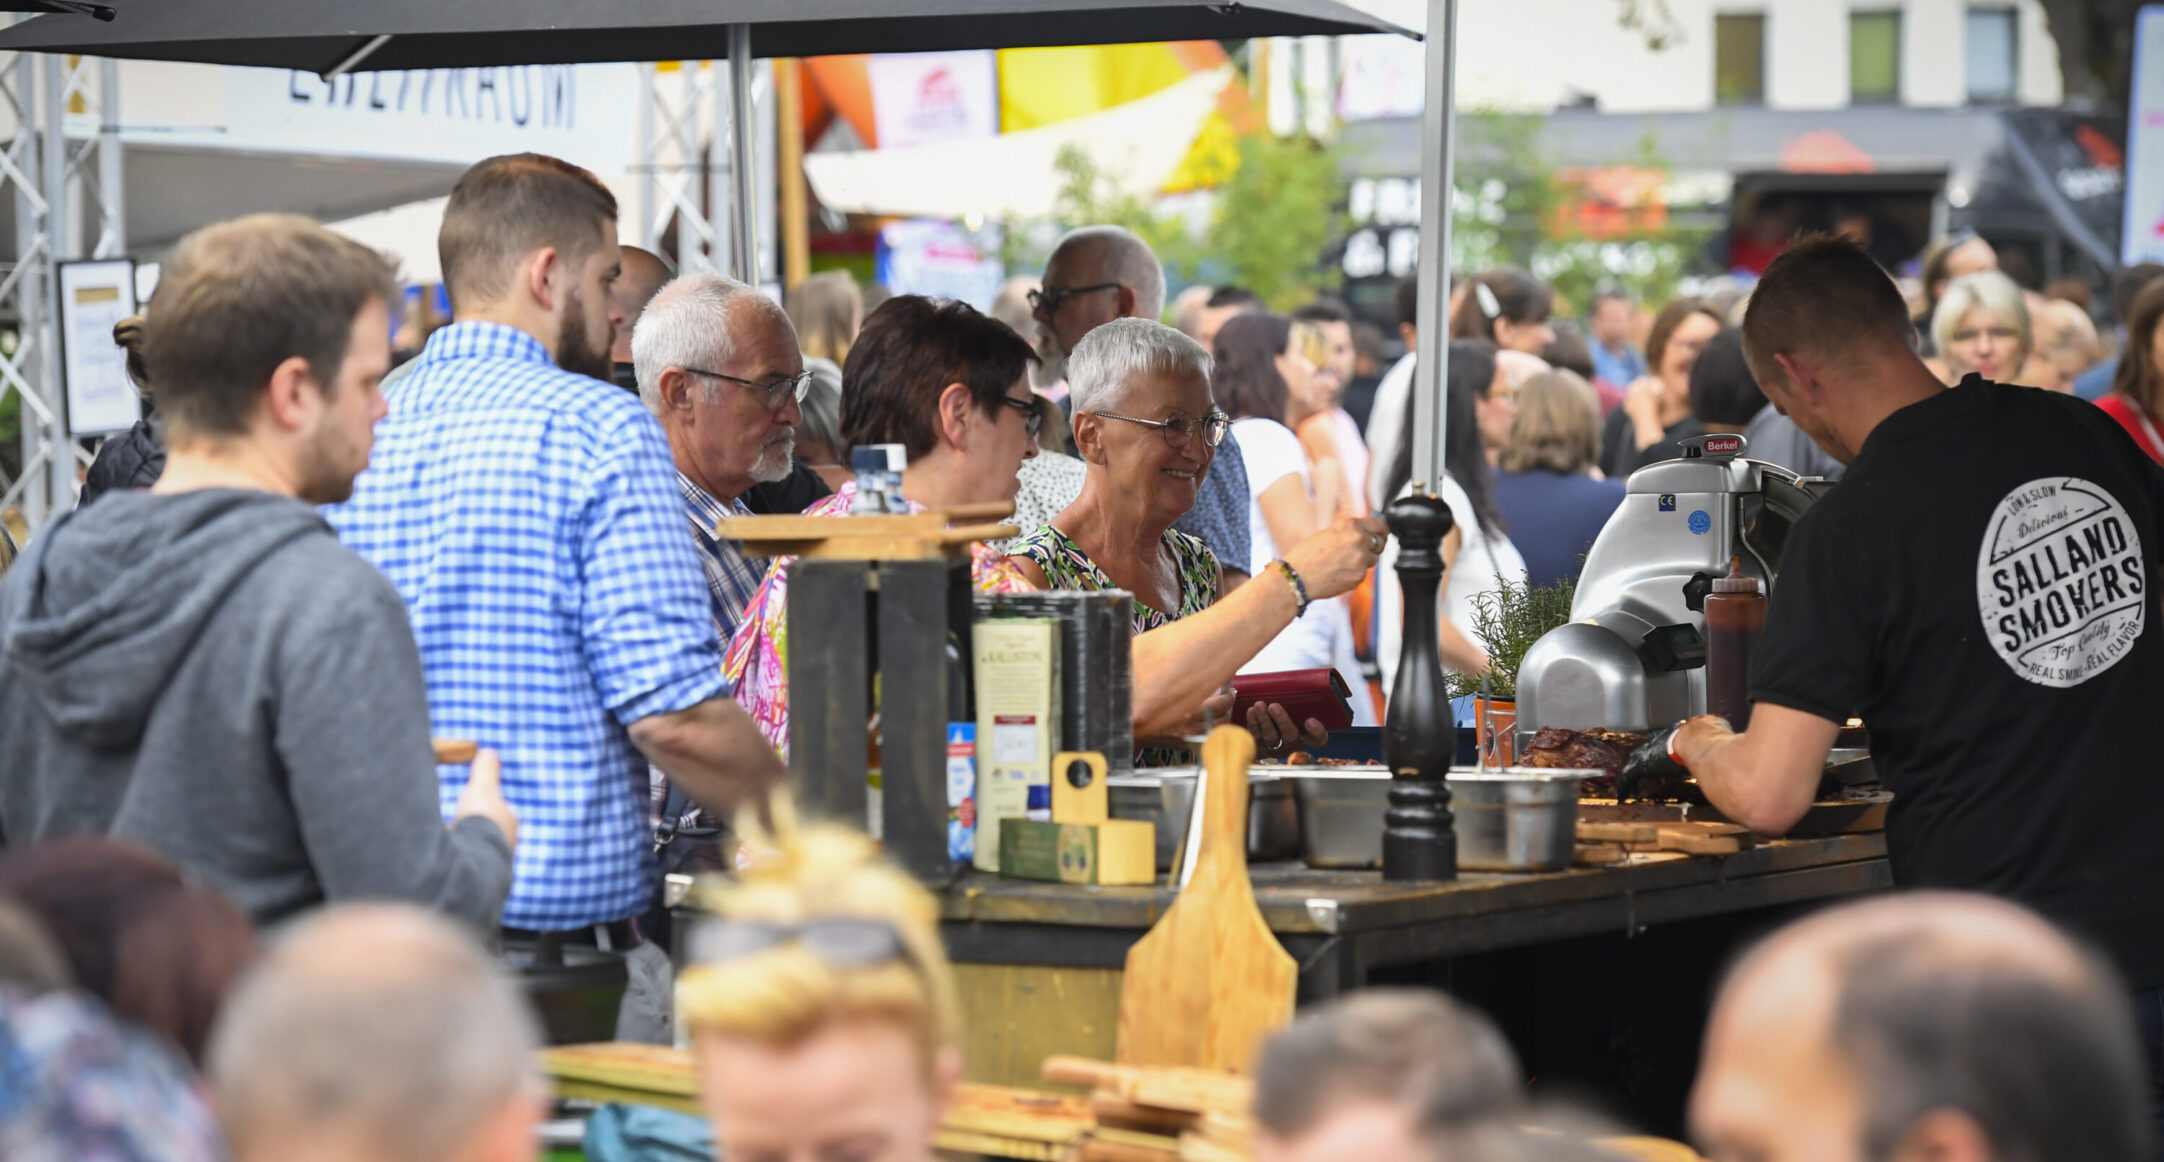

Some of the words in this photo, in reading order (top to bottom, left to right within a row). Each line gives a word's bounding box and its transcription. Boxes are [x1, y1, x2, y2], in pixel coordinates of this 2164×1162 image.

[1708, 441, 1738, 451] Berkel
[1992, 516, 2128, 608] SALLAND
[1999, 556, 2143, 653] SMOKERS
[2029, 662, 2055, 680] REAL
[2107, 620, 2140, 656] FLAVOR
[2050, 643, 2075, 661] Top
